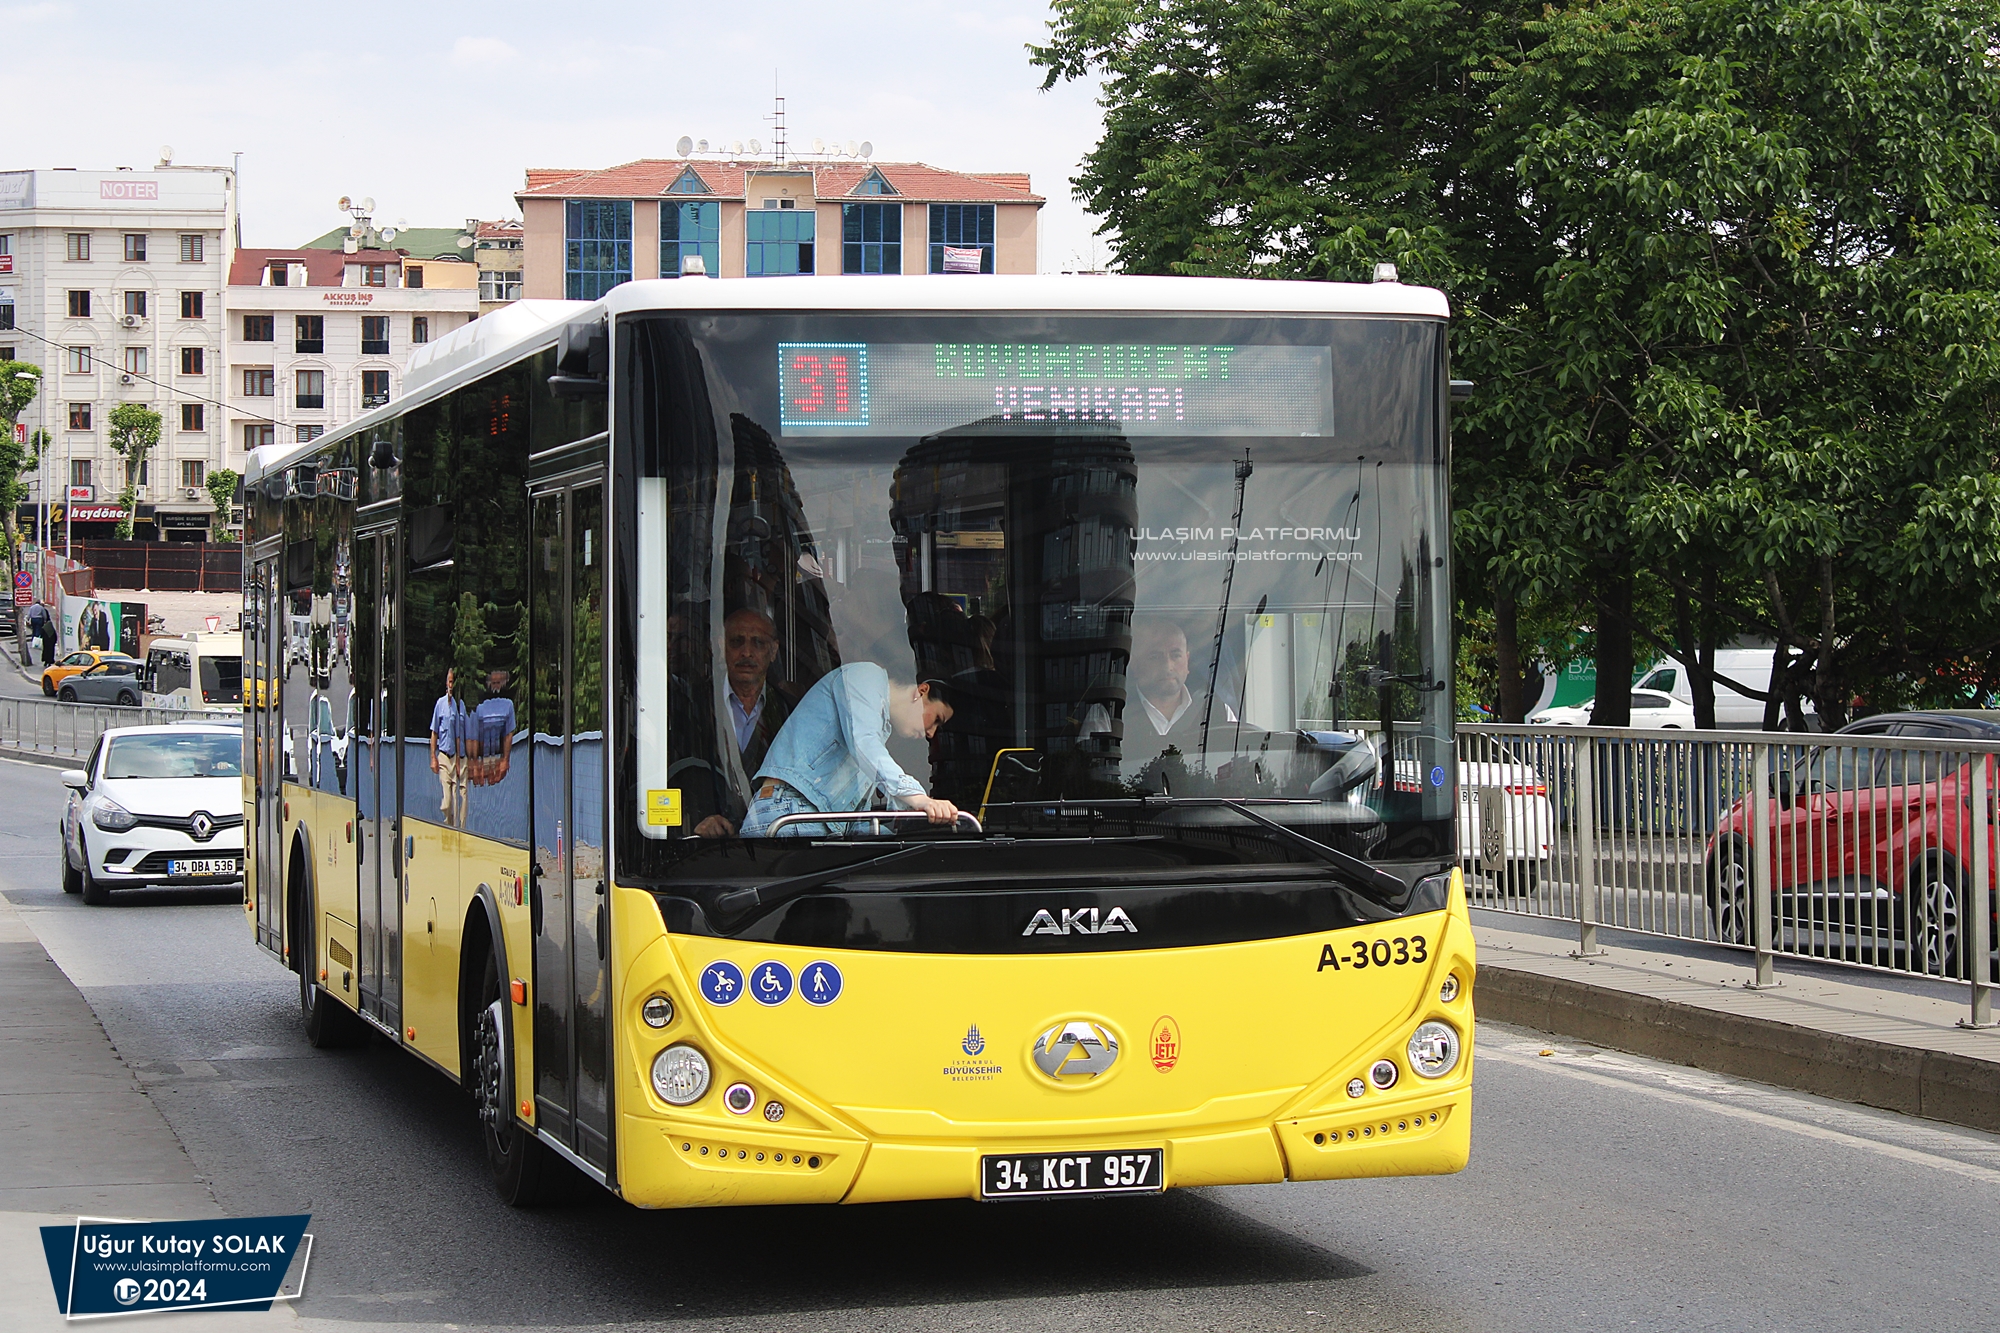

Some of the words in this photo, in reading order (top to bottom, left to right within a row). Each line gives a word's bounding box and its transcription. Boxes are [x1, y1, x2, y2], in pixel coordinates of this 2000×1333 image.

[102, 182, 156, 198] NOTER
[323, 293, 356, 303] AKKUŞ
[934, 342, 1235, 379] KUYUMCUKENT
[792, 355, 849, 412] 31
[71, 507, 129, 520] heydöner
[174, 861, 187, 873] 34
[191, 860, 211, 872] DBA
[214, 860, 233, 871] 536
[1022, 906, 1139, 936] AKIA
[1316, 935, 1428, 972] A-3033
[943, 1065, 1003, 1075] BÜYÜKŞEHİR
[996, 1160, 1028, 1190] 34
[1042, 1157, 1092, 1189] KCT
[1104, 1155, 1152, 1186] 957
